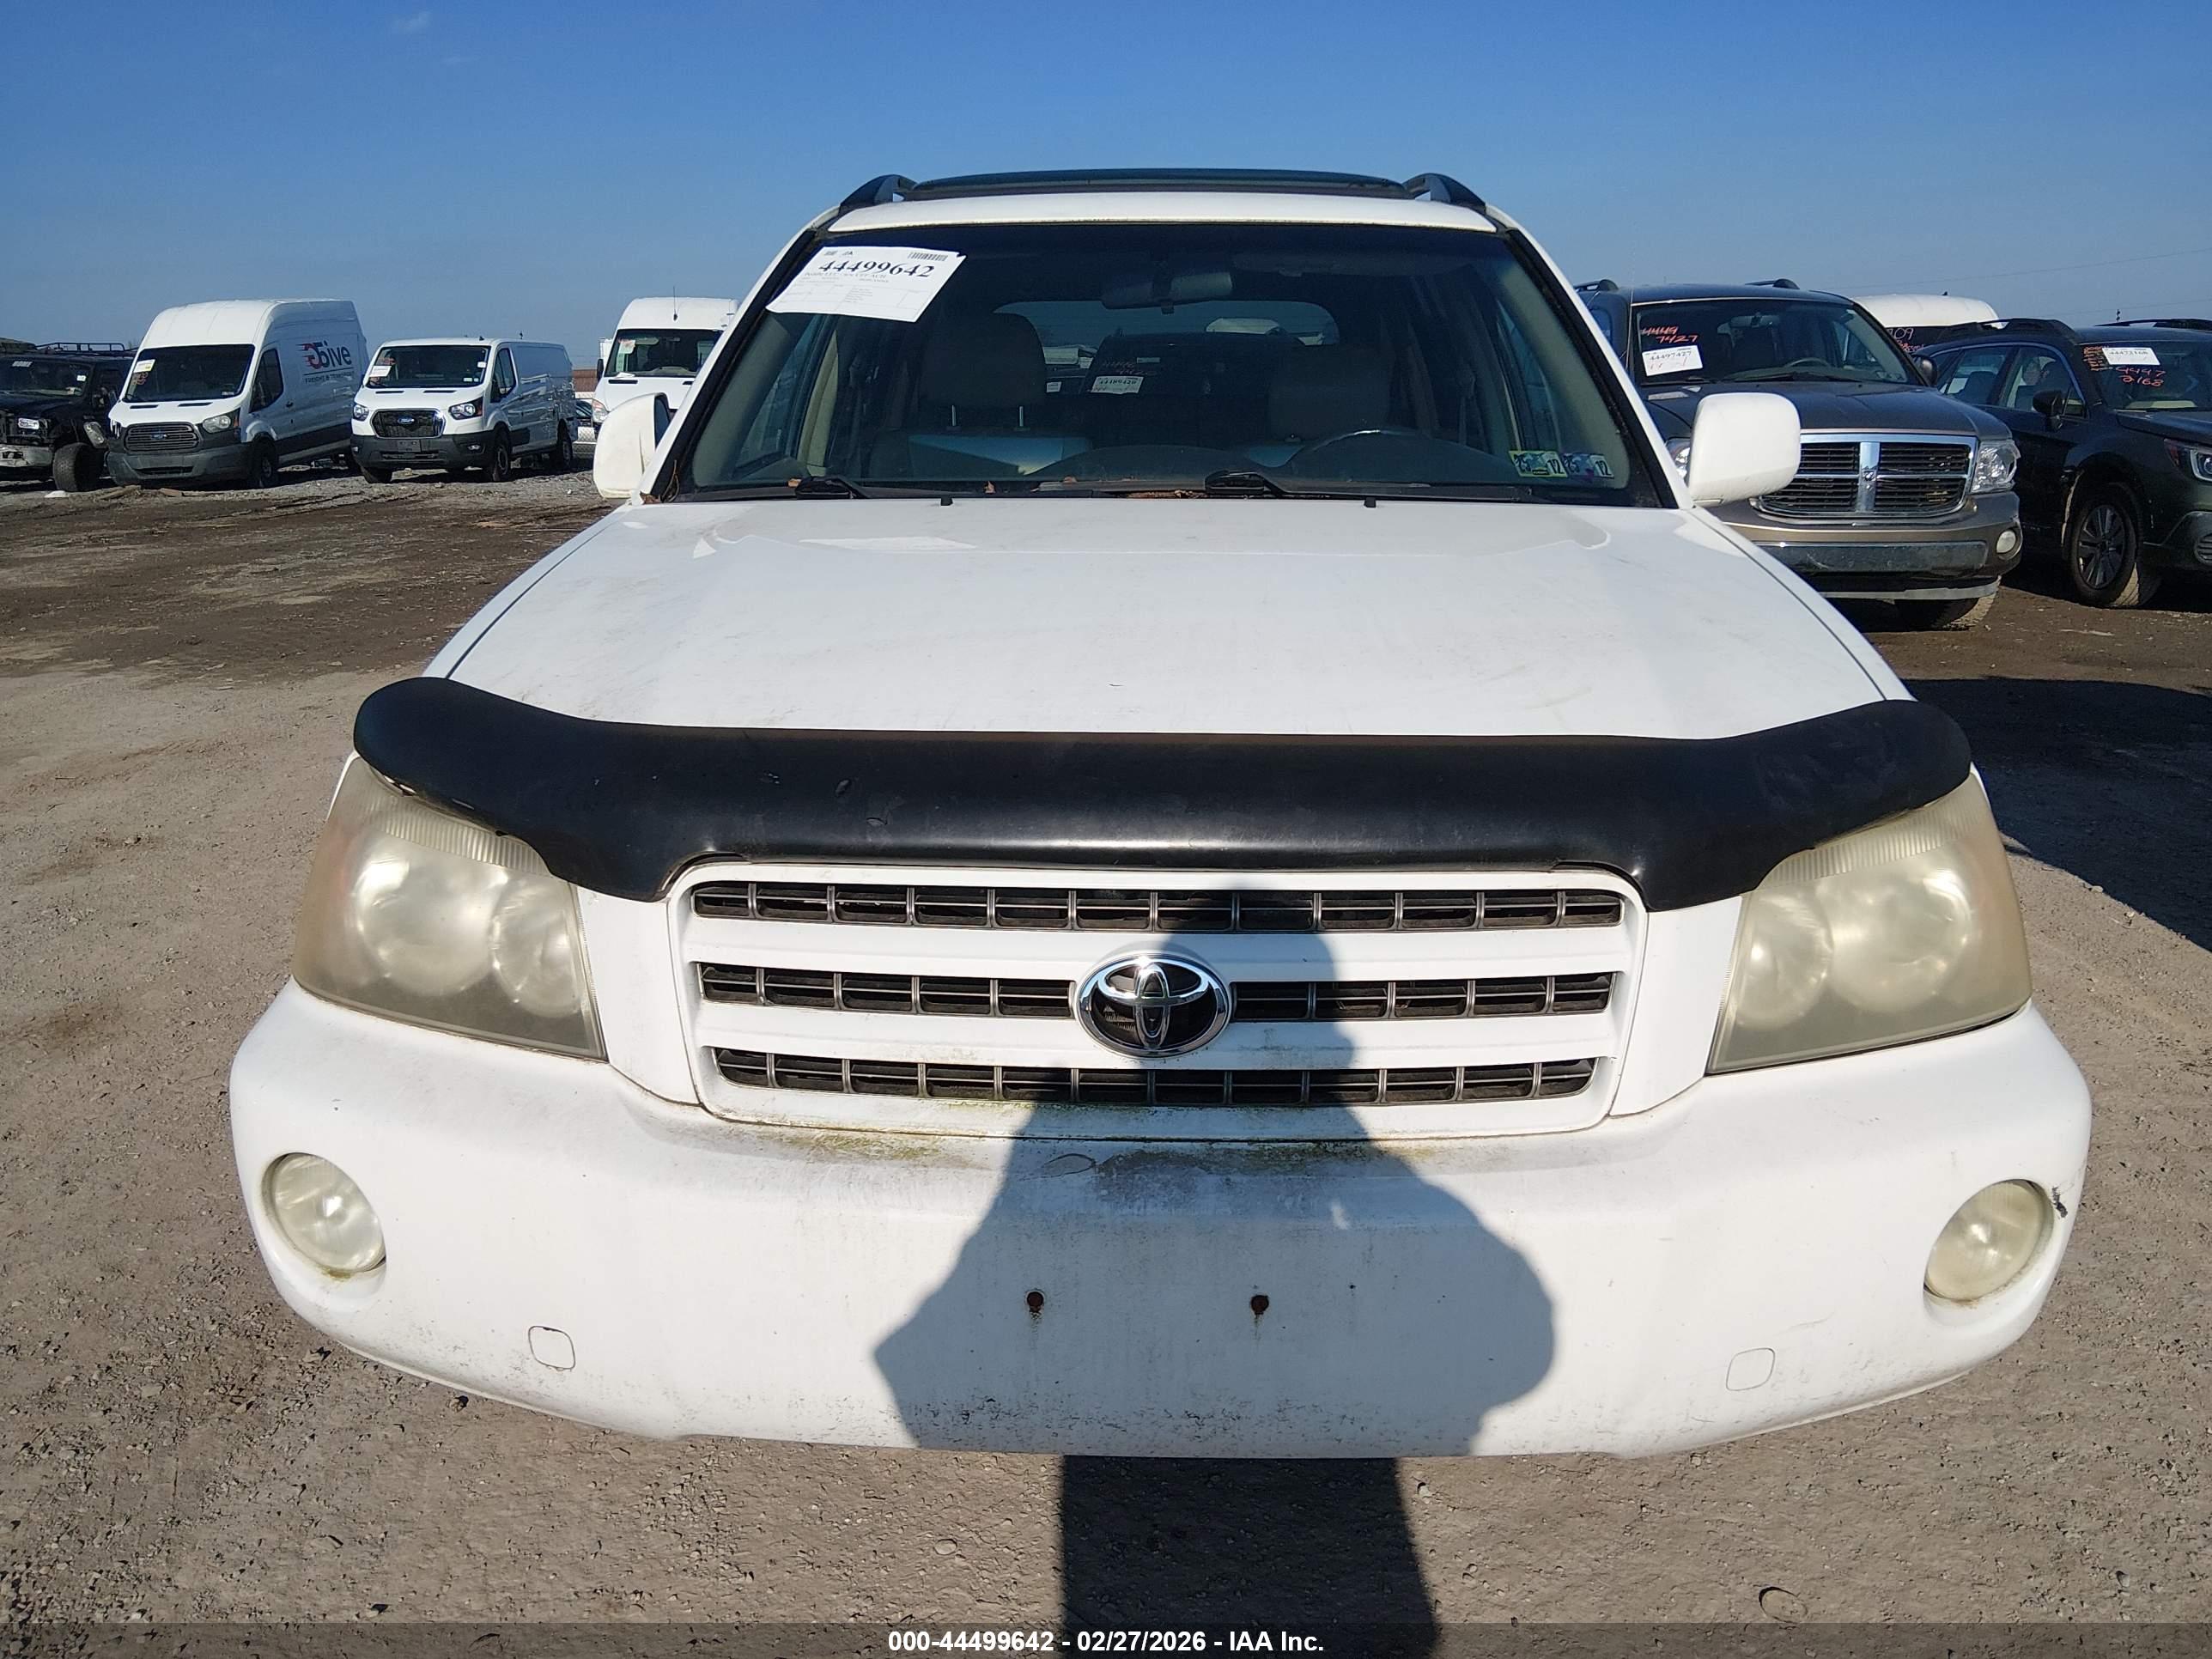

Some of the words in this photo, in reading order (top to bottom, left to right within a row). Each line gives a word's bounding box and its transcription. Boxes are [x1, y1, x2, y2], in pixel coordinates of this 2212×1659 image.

[818, 260, 934, 277] 44499642
[1656, 335, 1698, 343] 7427
[2116, 366, 2166, 377] 4447
[2119, 375, 2164, 386] 2168
